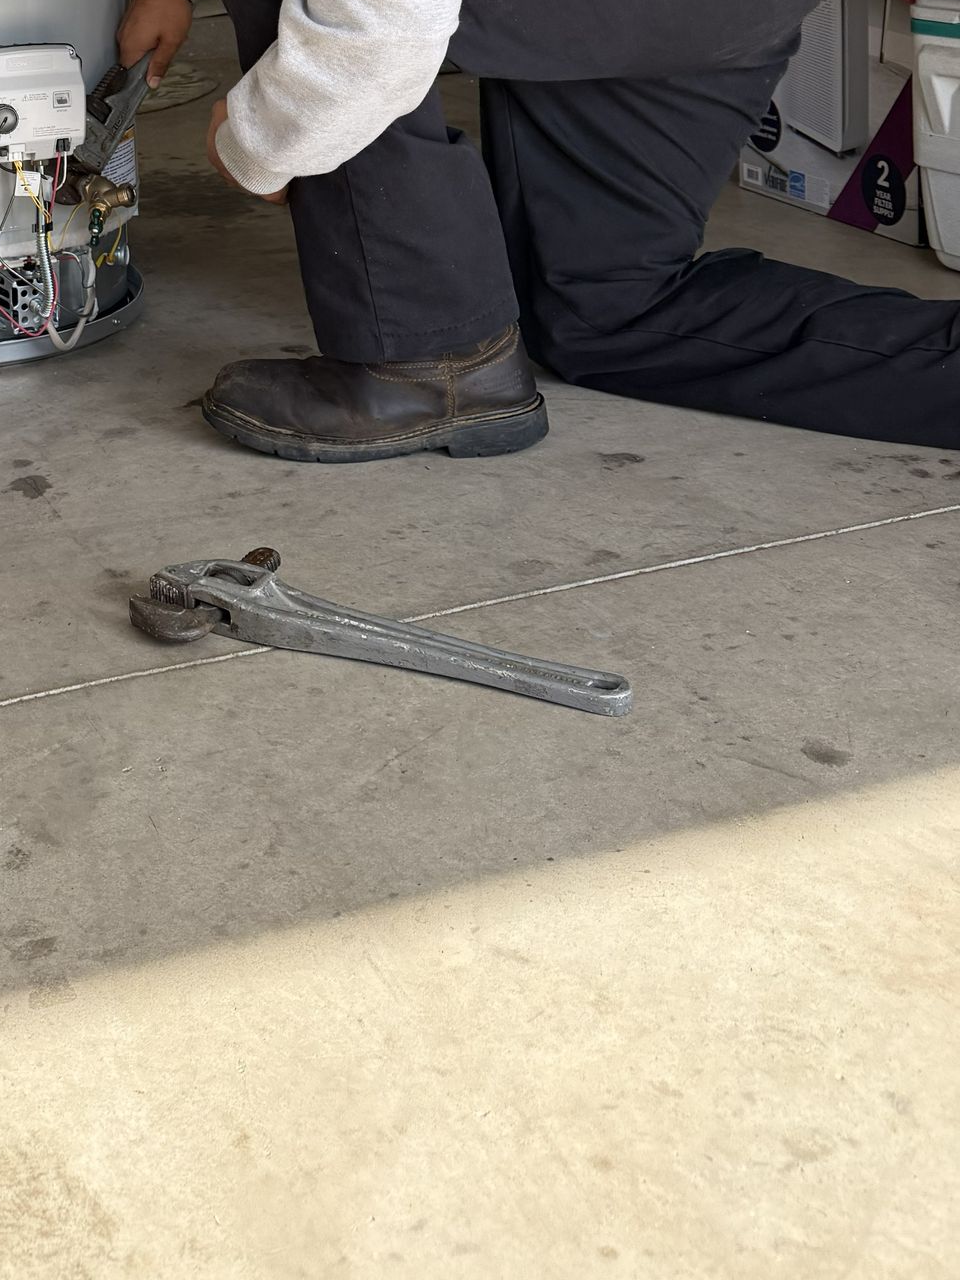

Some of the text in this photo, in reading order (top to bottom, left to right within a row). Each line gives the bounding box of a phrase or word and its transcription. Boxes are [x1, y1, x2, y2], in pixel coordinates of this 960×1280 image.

[877, 160, 890, 188] 2
[875, 189, 891, 201] YEAR
[874, 197, 893, 210] FILTER
[873, 205, 894, 219] SUPPLY
